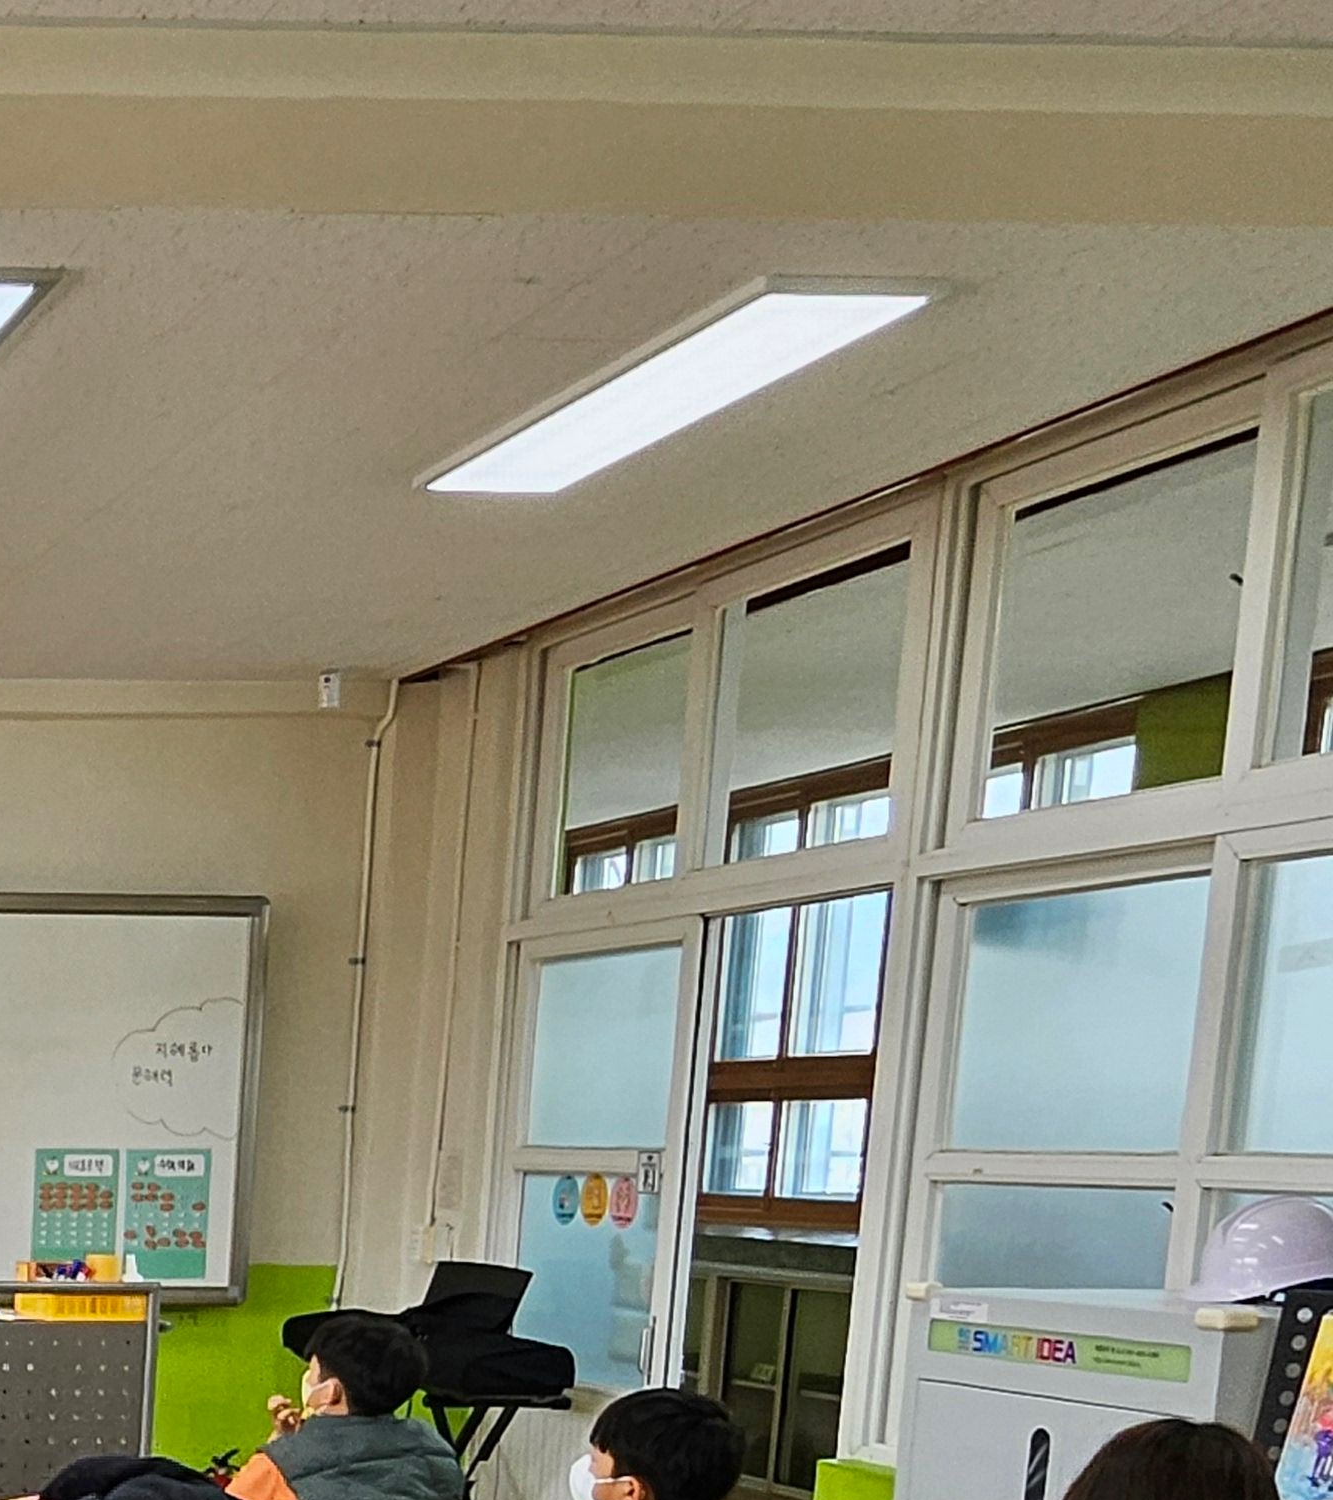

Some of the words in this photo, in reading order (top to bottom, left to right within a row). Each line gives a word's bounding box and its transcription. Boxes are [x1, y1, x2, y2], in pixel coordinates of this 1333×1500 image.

[155, 1041, 213, 1063] 지혜롭다
[972, 1329, 1033, 1361] SMART
[1035, 1336, 1077, 1365] IDEA
